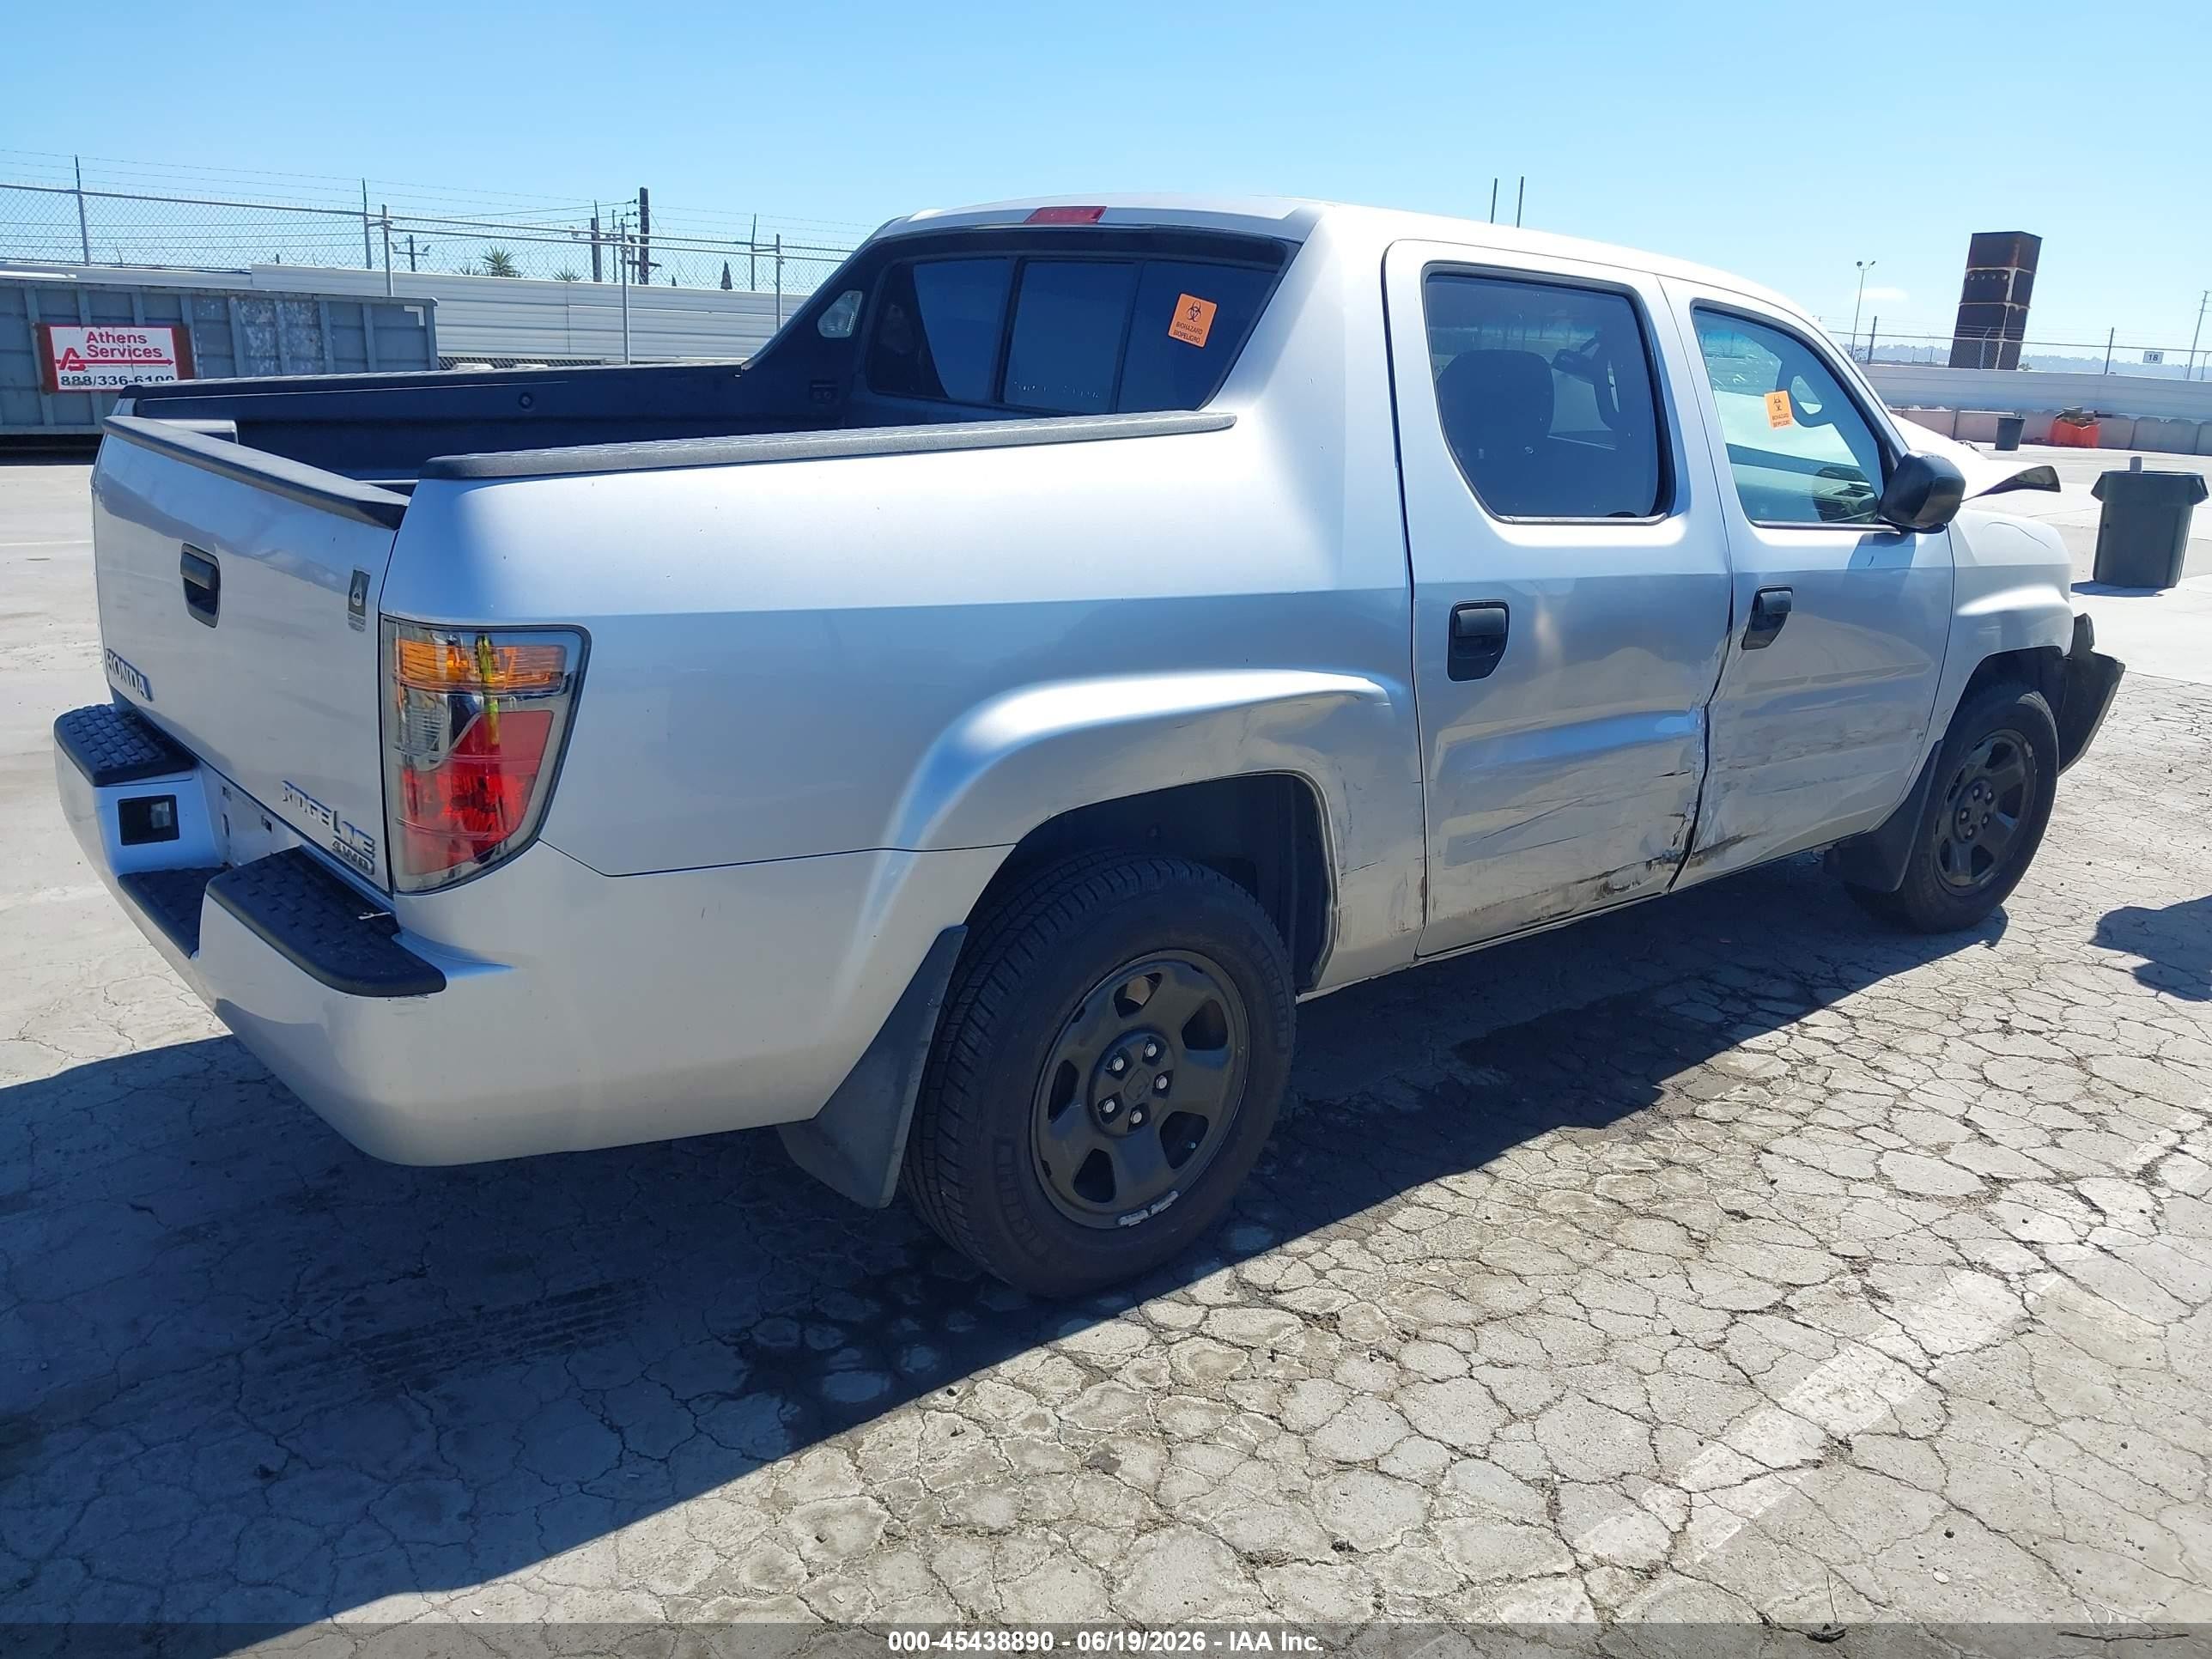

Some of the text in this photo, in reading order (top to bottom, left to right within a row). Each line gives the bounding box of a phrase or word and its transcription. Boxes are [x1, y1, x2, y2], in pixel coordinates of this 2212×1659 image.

[86, 331, 148, 344] Athens
[87, 345, 163, 358] Services
[106, 648, 152, 701] HONDA
